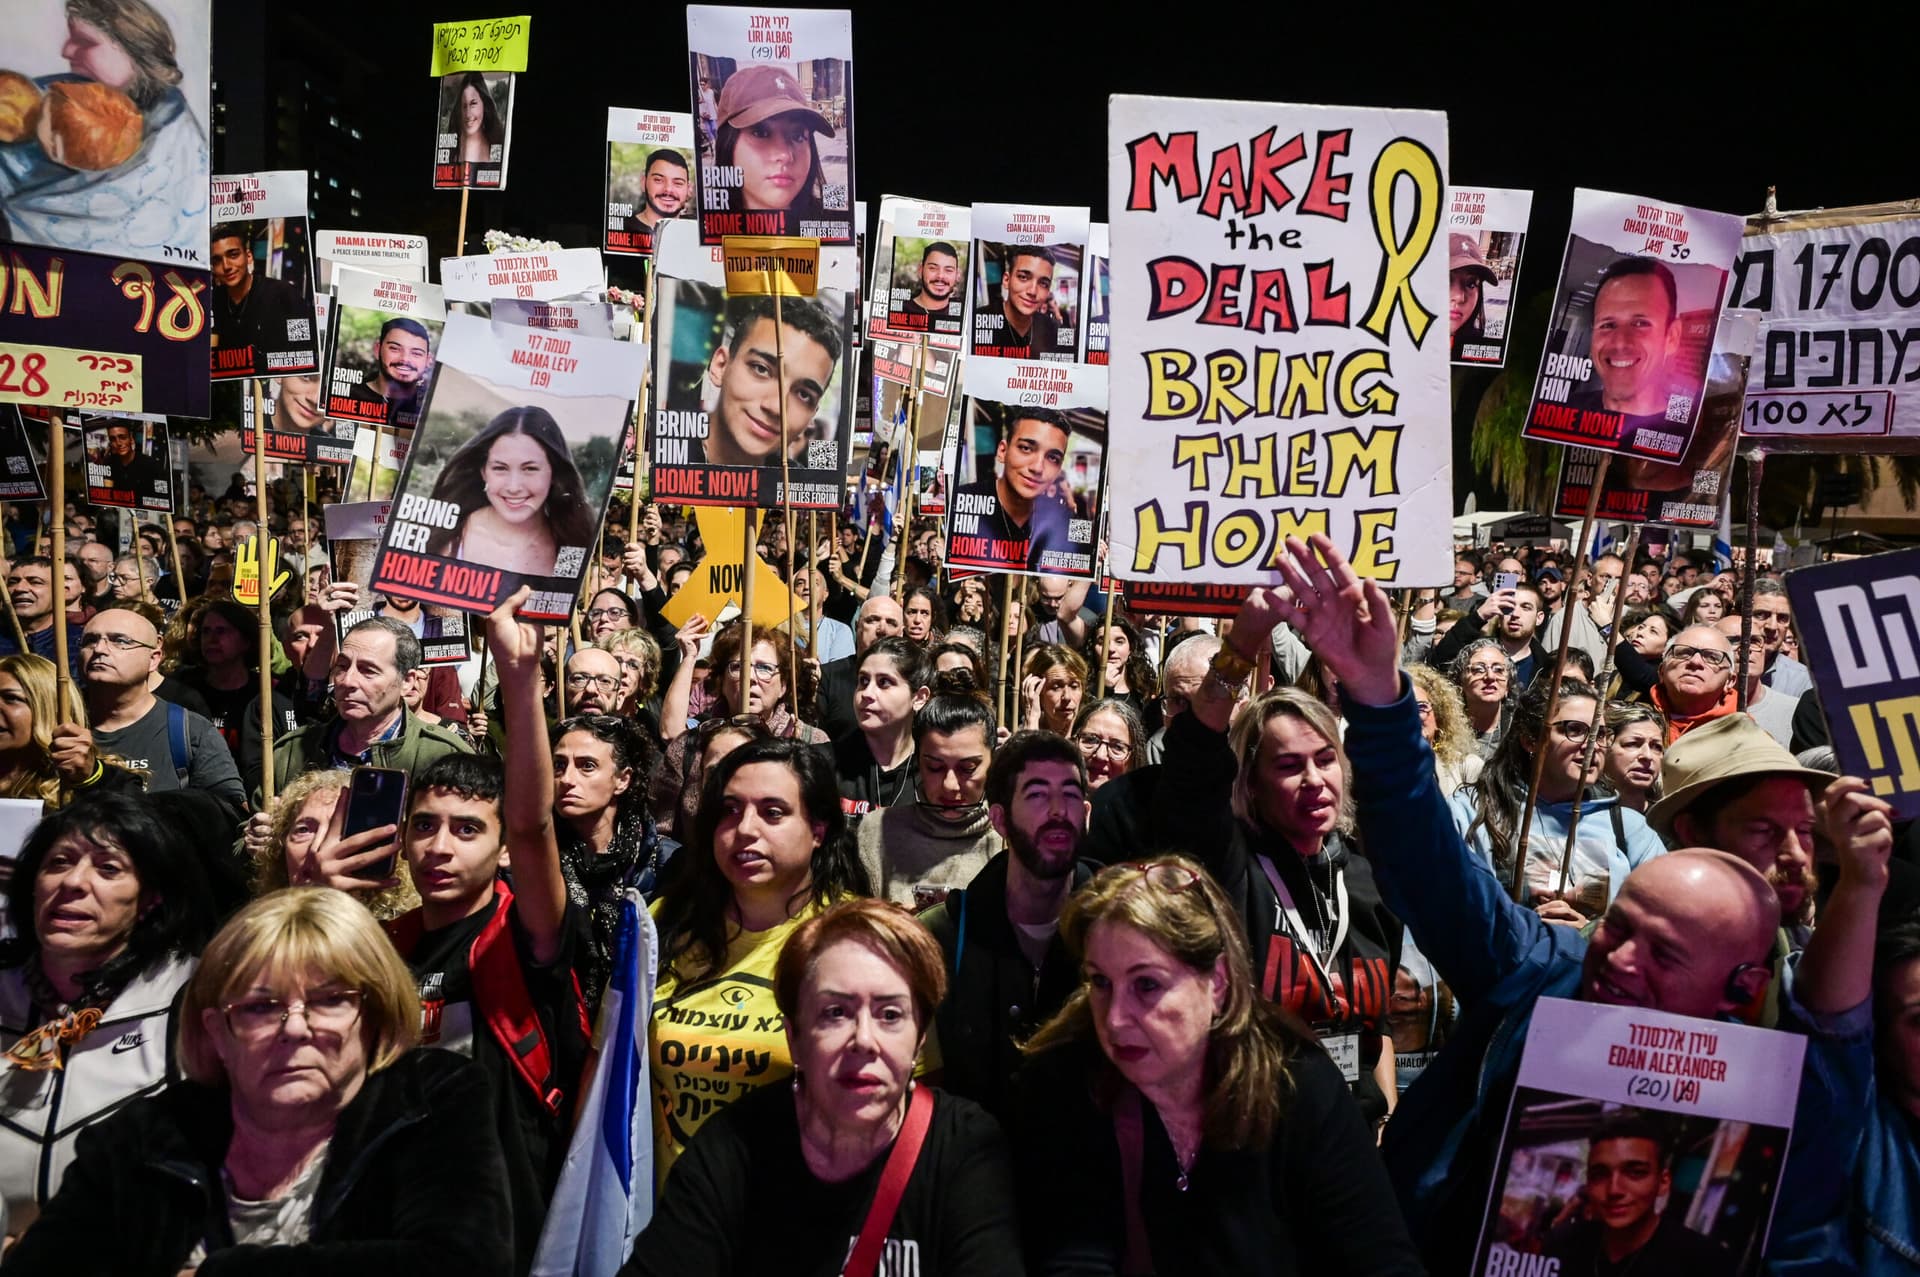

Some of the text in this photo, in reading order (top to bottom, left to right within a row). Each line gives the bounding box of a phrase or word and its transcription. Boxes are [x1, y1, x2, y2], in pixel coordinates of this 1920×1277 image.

[750, 15, 791, 29] לירי אלבג
[748, 30, 793, 44] LIRI ALBAG
[751, 46, 773, 59] (19)
[703, 166, 744, 188] BRING
[1126, 125, 1353, 222] MAKE
[703, 188, 730, 210] HER
[218, 206, 239, 217] (20)
[608, 202, 633, 218] BRING
[1451, 203, 1485, 214] LIRI ALBAG
[1636, 204, 1684, 227] אוהד יהלומי
[608, 215, 625, 231] HIM
[705, 210, 786, 235] HOME NOW!
[1006, 223, 1056, 234] EDAN ALEXANDER
[1623, 218, 1689, 244] OHAD YAHALOMI
[335, 236, 424, 249] NAAMA LEVY 20
[607, 231, 652, 247] HOME NOW
[800, 228, 849, 239] FAMILIES FORUM
[1016, 234, 1033, 244] (20)
[1224, 218, 1303, 251] the
[163, 245, 199, 261] אורה
[382, 251, 410, 259] TRIATHLETE
[1670, 244, 1691, 260] 50
[494, 256, 549, 271] עידן אלכסנדר
[726, 256, 815, 275] אחות חטופה בעזה
[488, 269, 559, 286] EDAN ALEXANDER
[373, 288, 417, 303] OMER WENKERT
[516, 285, 534, 298] (20)
[891, 288, 912, 301] BRING
[1146, 255, 1351, 334] DEAL
[378, 300, 396, 310] (23)
[528, 317, 579, 329] EDAN ALEXANDER
[889, 313, 909, 326] HOME
[975, 313, 1004, 329] BRING
[975, 329, 993, 344] HIM
[1089, 322, 1109, 337] BRIN
[528, 334, 572, 355] נעמה לוי
[1088, 336, 1106, 351] HIM
[77, 355, 134, 373] כבר
[218, 345, 254, 368] NOW!
[511, 350, 579, 374] NAAMA LEVY
[333, 367, 363, 385] BRING
[1016, 365, 1068, 381] עידן אלכסנדר
[1544, 352, 1594, 383] BRING
[530, 370, 552, 388] (19)
[1007, 377, 1074, 394] EDAN ALEXANDER
[1141, 344, 1400, 425] BRING
[331, 381, 351, 397] HIM
[1539, 377, 1572, 404] HIM
[329, 397, 357, 415] HOME
[358, 403, 389, 418] NOW!
[1019, 393, 1042, 405] (20)
[1747, 395, 1872, 427] לא 100
[656, 410, 709, 439] BRING
[1532, 402, 1625, 440] HOME NOW!
[275, 436, 308, 454] NOW!
[656, 438, 689, 464] HIM
[88, 463, 112, 477] BRING
[1173, 424, 1405, 498] THEM
[89, 476, 105, 488] HIM
[655, 468, 759, 498] HOME NOW!
[1566, 465, 1594, 486] HIM
[811, 492, 839, 505] FORUM
[956, 493, 996, 516] BRING
[1608, 490, 1650, 512] NOW!
[373, 515, 386, 524] TAL
[396, 493, 461, 530] BRING
[1660, 508, 1717, 524] FAMILIES FORUM
[953, 513, 980, 535] HIM
[388, 523, 431, 554] HER
[1131, 498, 1401, 582] HOME
[951, 536, 1030, 562] HOME NOW!
[1041, 557, 1091, 571] FAMILIES FORUM
[379, 551, 502, 601] HOME NOW!
[658, 1006, 785, 1033] לא עוצמות
[119, 1033, 142, 1046] NIKE
[1628, 1023, 1718, 1056] עידן אלכסנדר
[660, 1040, 771, 1077] עיניים
[1608, 1044, 1728, 1083] EDAN ALEXANDER
[1627, 1075, 1672, 1100] (20)
[1485, 1248, 1561, 1277] BRING
